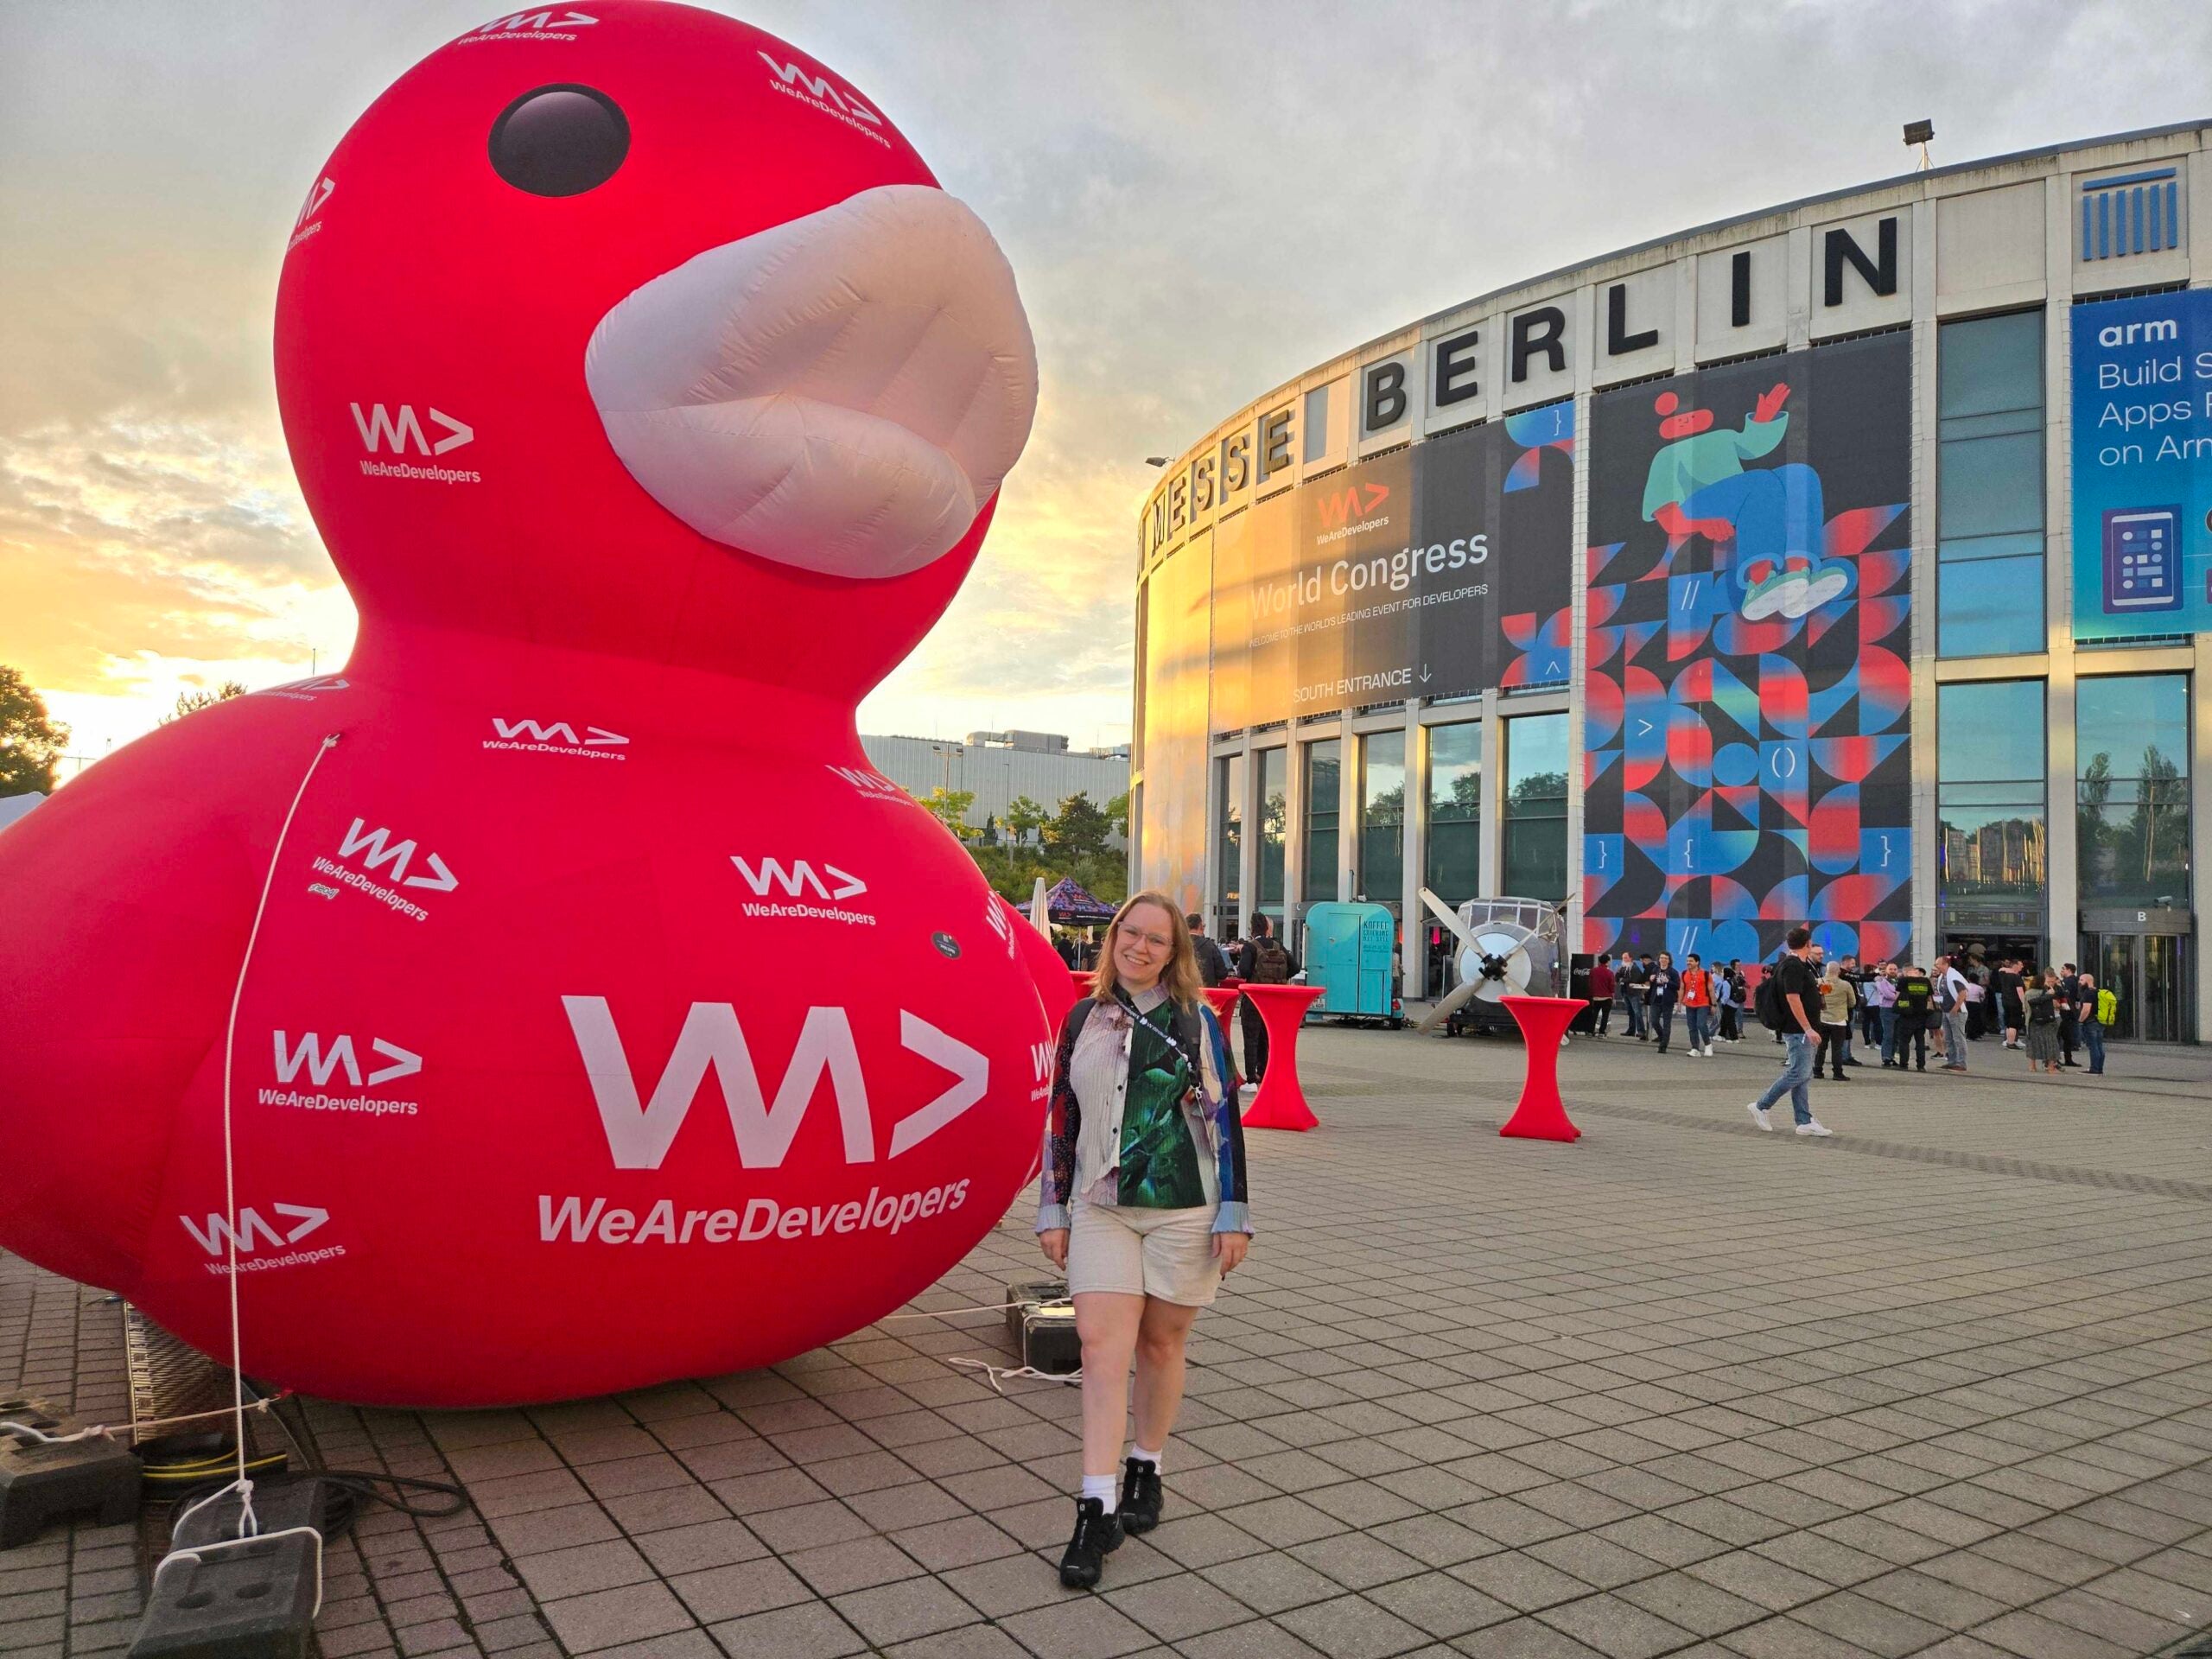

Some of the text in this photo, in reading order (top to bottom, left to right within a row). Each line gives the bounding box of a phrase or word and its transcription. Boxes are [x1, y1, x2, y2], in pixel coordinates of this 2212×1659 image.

[769, 79, 891, 149] WeAreDevelopers
[1366, 217, 1897, 431] BERLIN
[2098, 319, 2177, 347] arm
[2099, 356, 2181, 389] Build
[2098, 401, 2192, 432] Apps
[2099, 445, 2143, 466] on
[359, 461, 481, 485] WeAreDevelopers
[1317, 516, 1389, 545] WeAreDevelopers
[1250, 534, 1489, 620] World Congress
[1249, 583, 1489, 648] WELCOME TO THE WORLD'S LEADING EVENT FOR DEVELOPERS
[1293, 668, 1412, 703] SOUTH ENTRANCE
[482, 741, 626, 760] WeAreDevelopers
[311, 856, 429, 921] WeAreDevelopers
[742, 903, 876, 926] WeAreDevelopers
[2138, 911, 2146, 922] B
[258, 1088, 418, 1116] WeAreDevelopers
[537, 1177, 971, 1244] WeAreDevelopers
